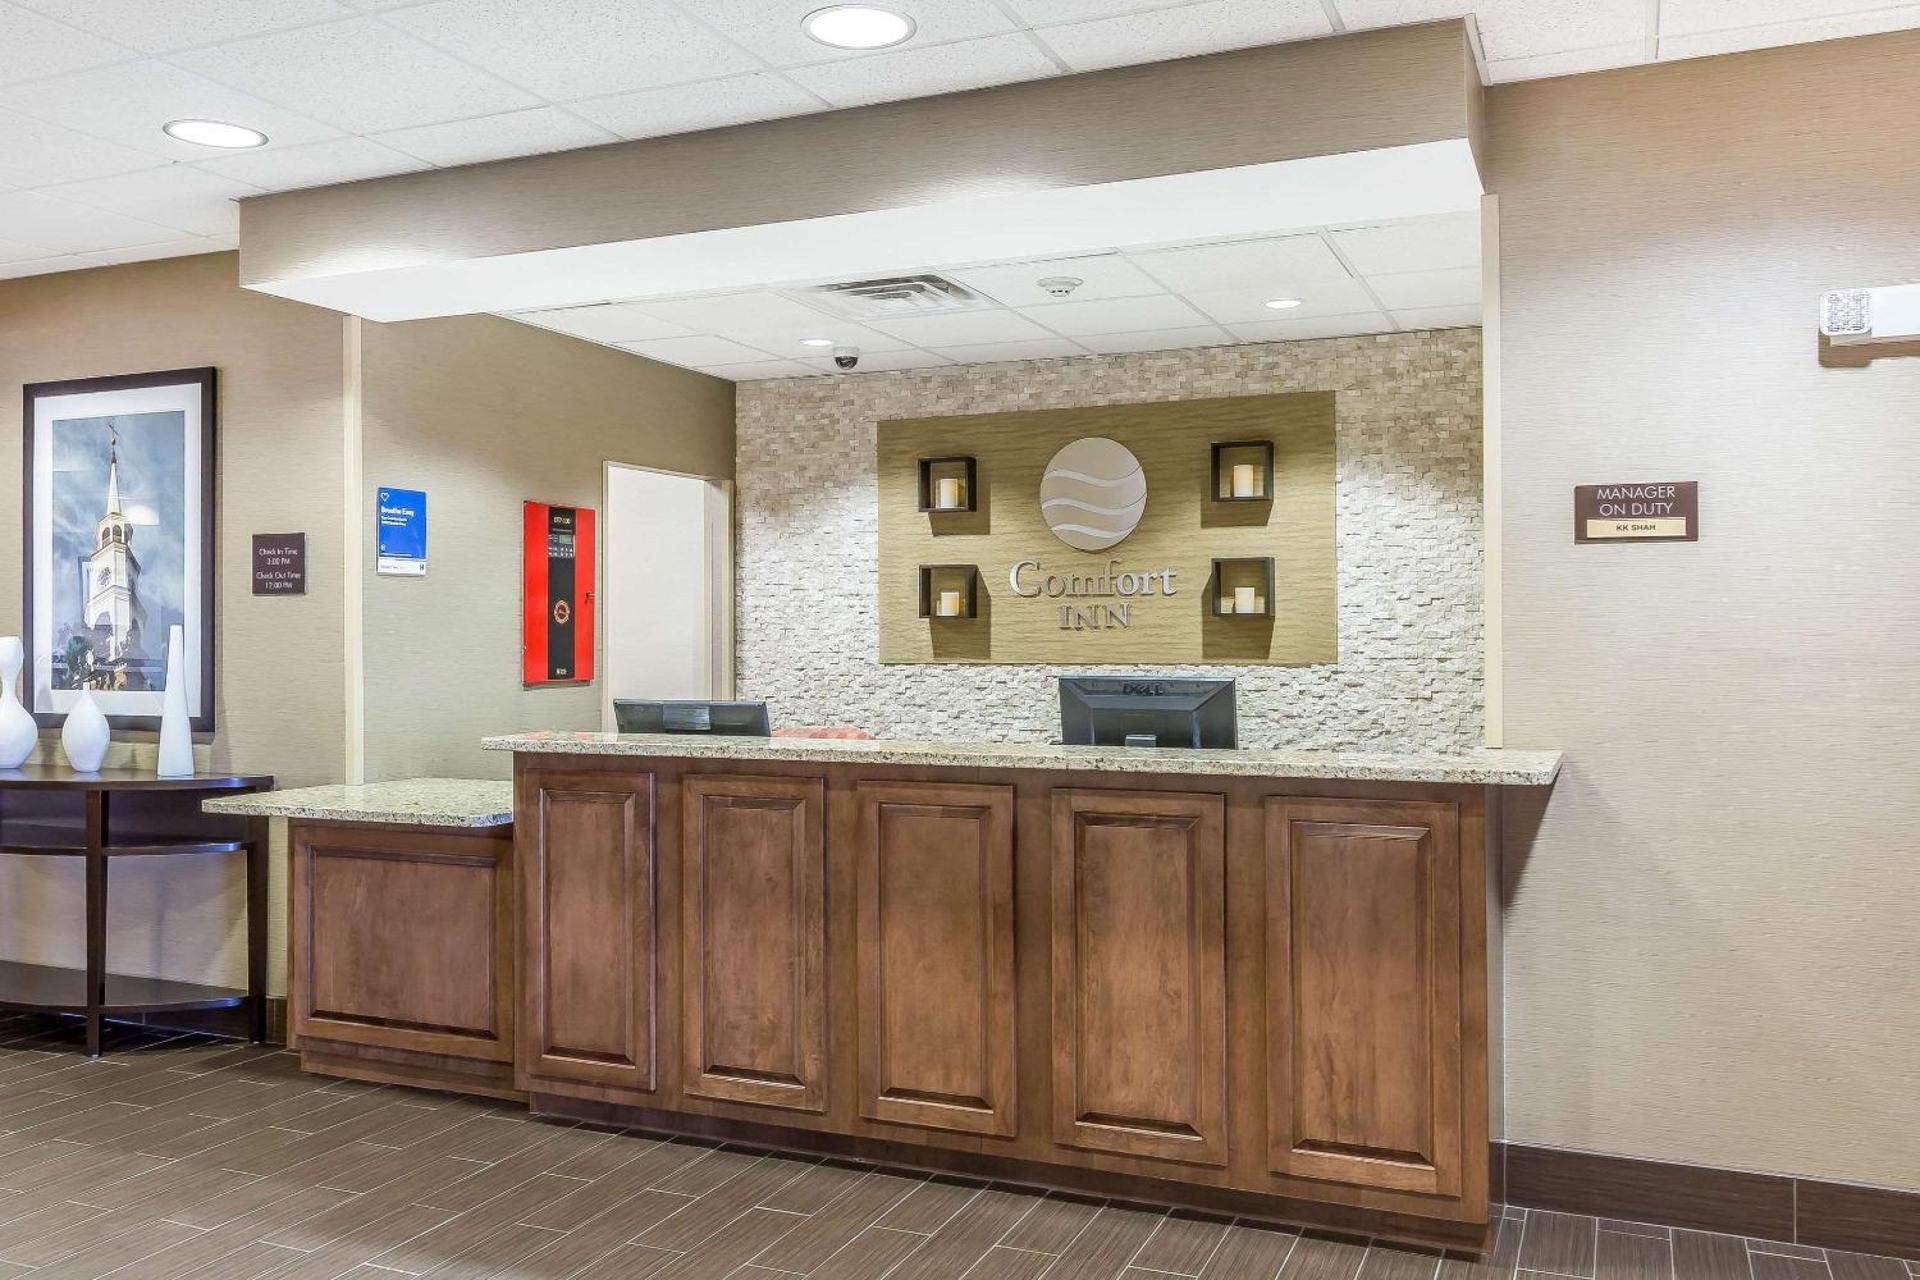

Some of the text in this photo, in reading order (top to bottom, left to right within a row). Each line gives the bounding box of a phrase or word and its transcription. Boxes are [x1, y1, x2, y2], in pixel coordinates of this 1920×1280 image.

[1597, 485, 1676, 500] MANAGER
[1599, 502, 1674, 517] ON DUTY
[258, 548, 276, 556] Check
[284, 547, 298, 555] Time
[281, 557, 291, 565] PM
[255, 571, 301, 579] Check Out Time
[1008, 557, 1178, 598] Comfort
[1057, 601, 1132, 631] INN
[1122, 681, 1164, 696] DELL
